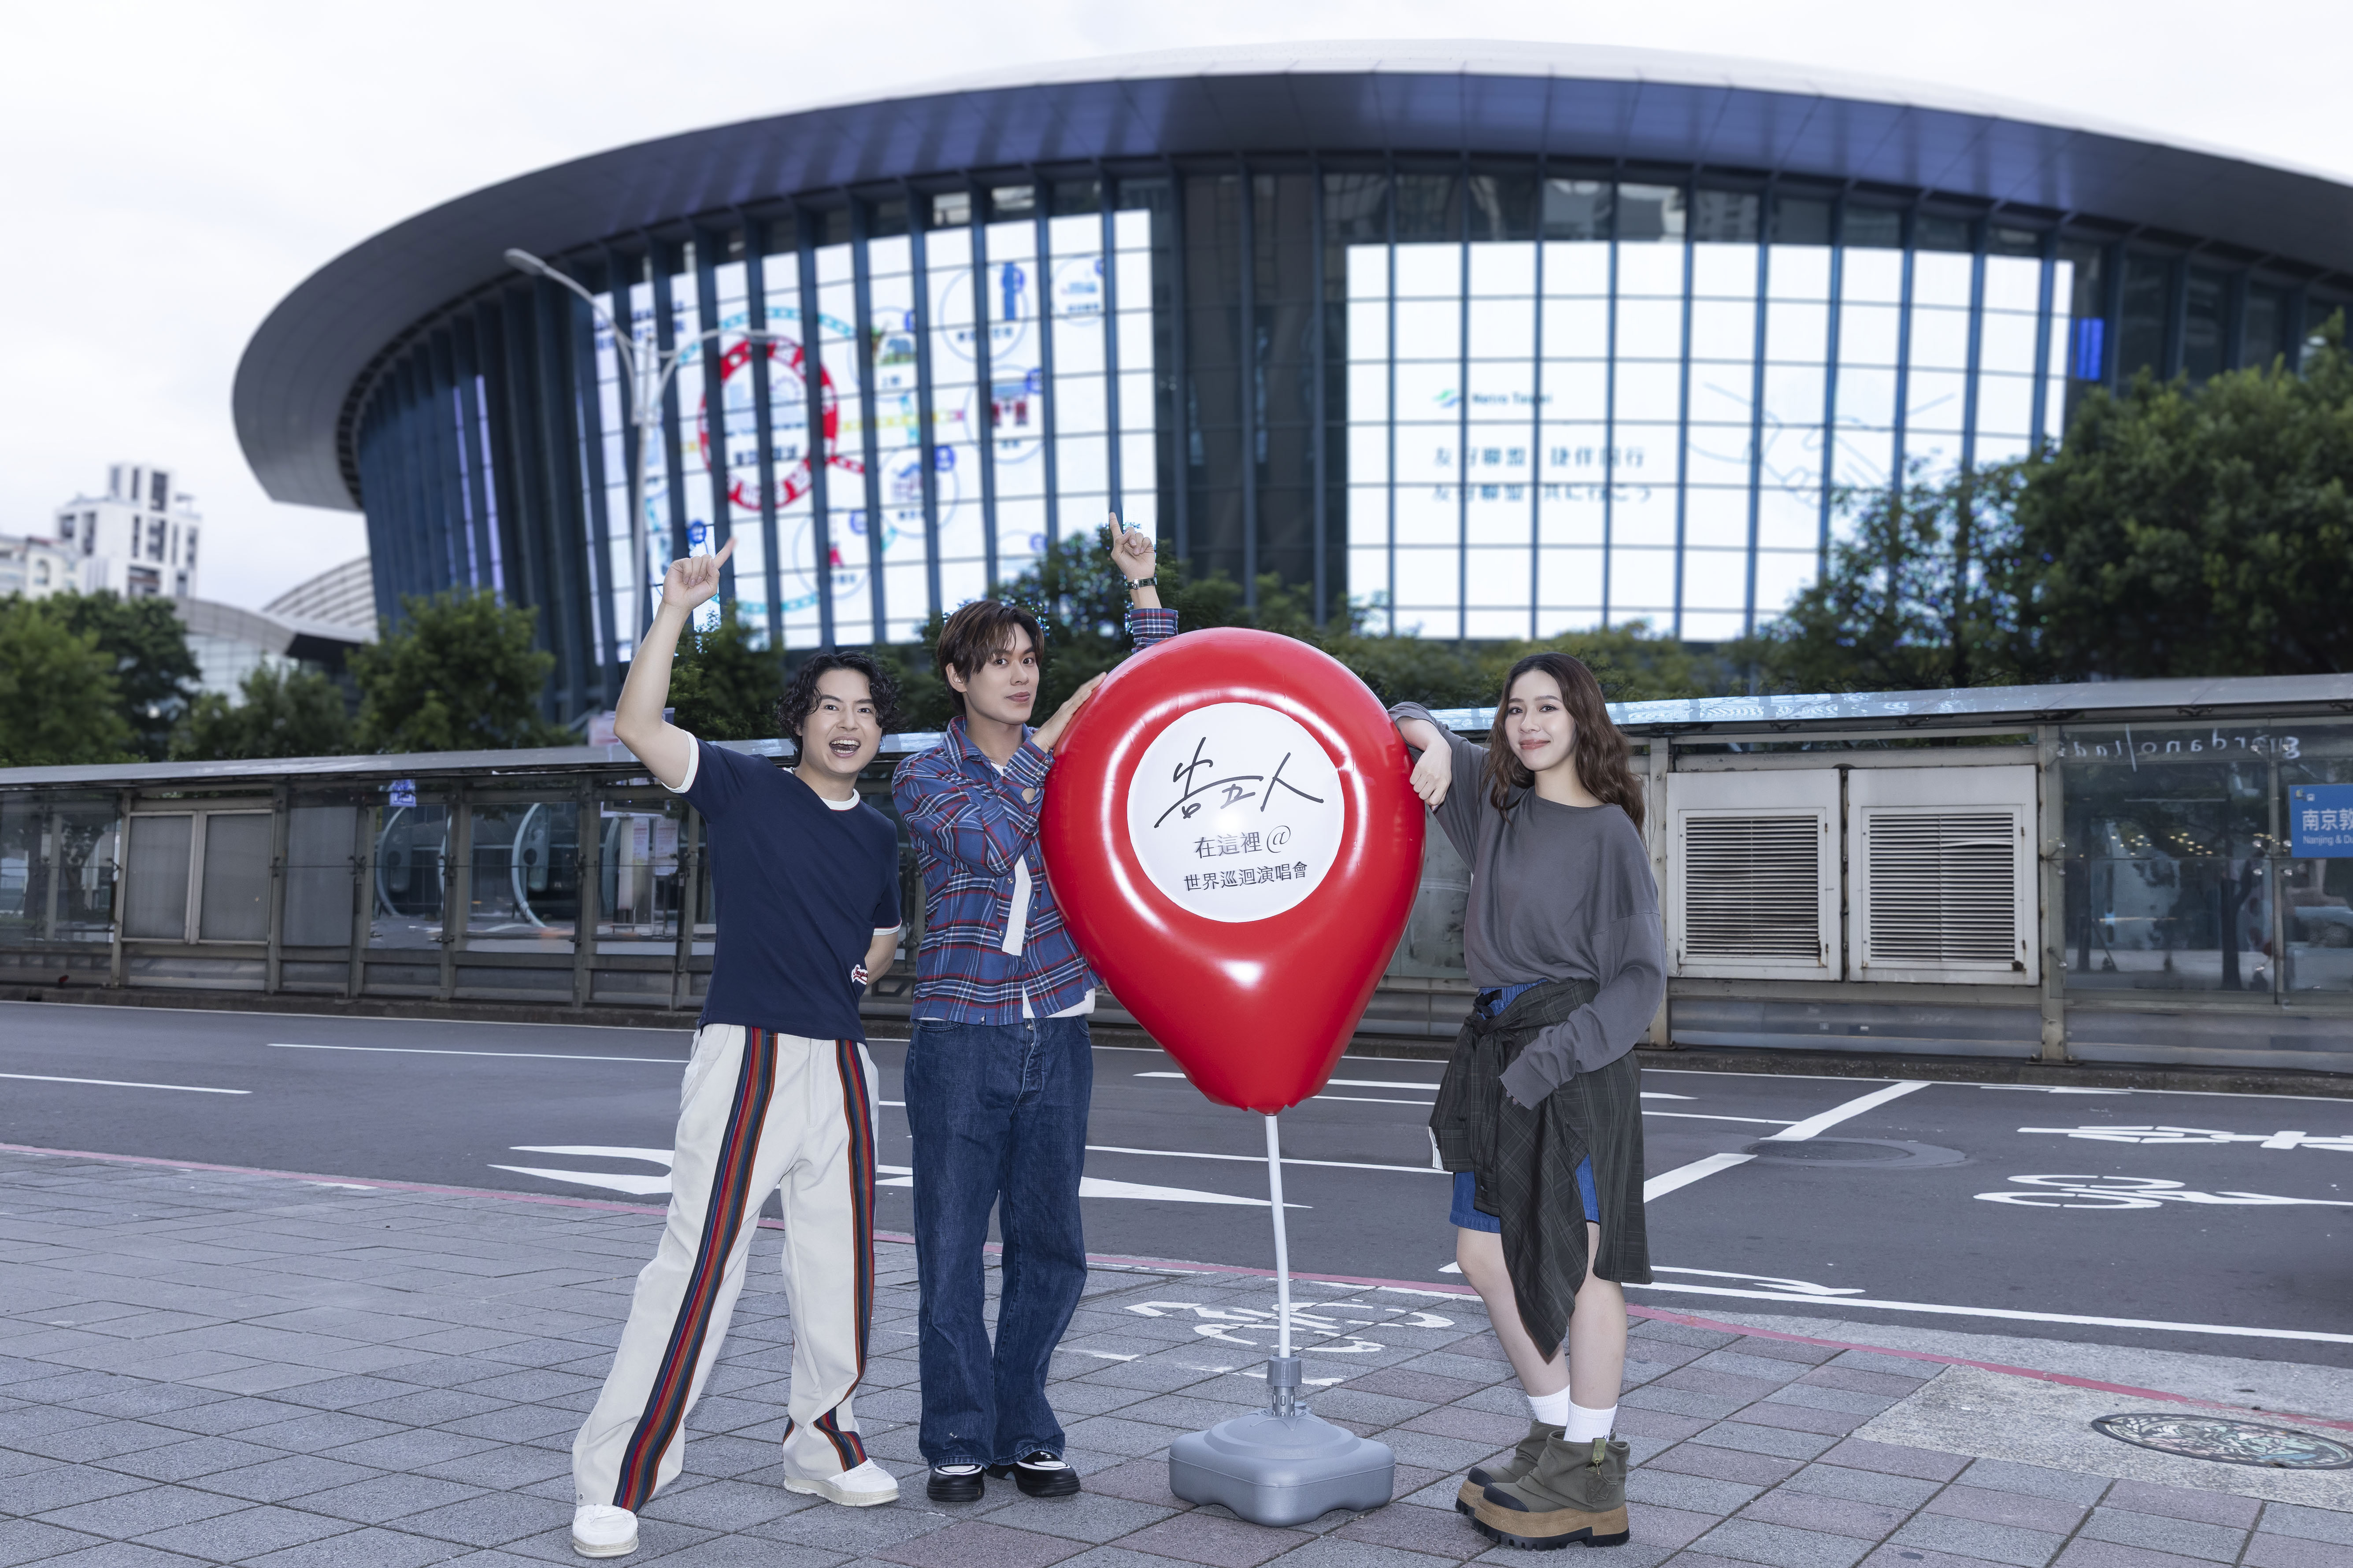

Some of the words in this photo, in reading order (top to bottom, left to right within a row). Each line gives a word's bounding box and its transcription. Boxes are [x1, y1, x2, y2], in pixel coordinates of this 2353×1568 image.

[1153, 736, 1324, 828] 告五人
[2303, 836, 2334, 846] Nanjing
[1183, 861, 1308, 891] 世界巡迴演唱會
